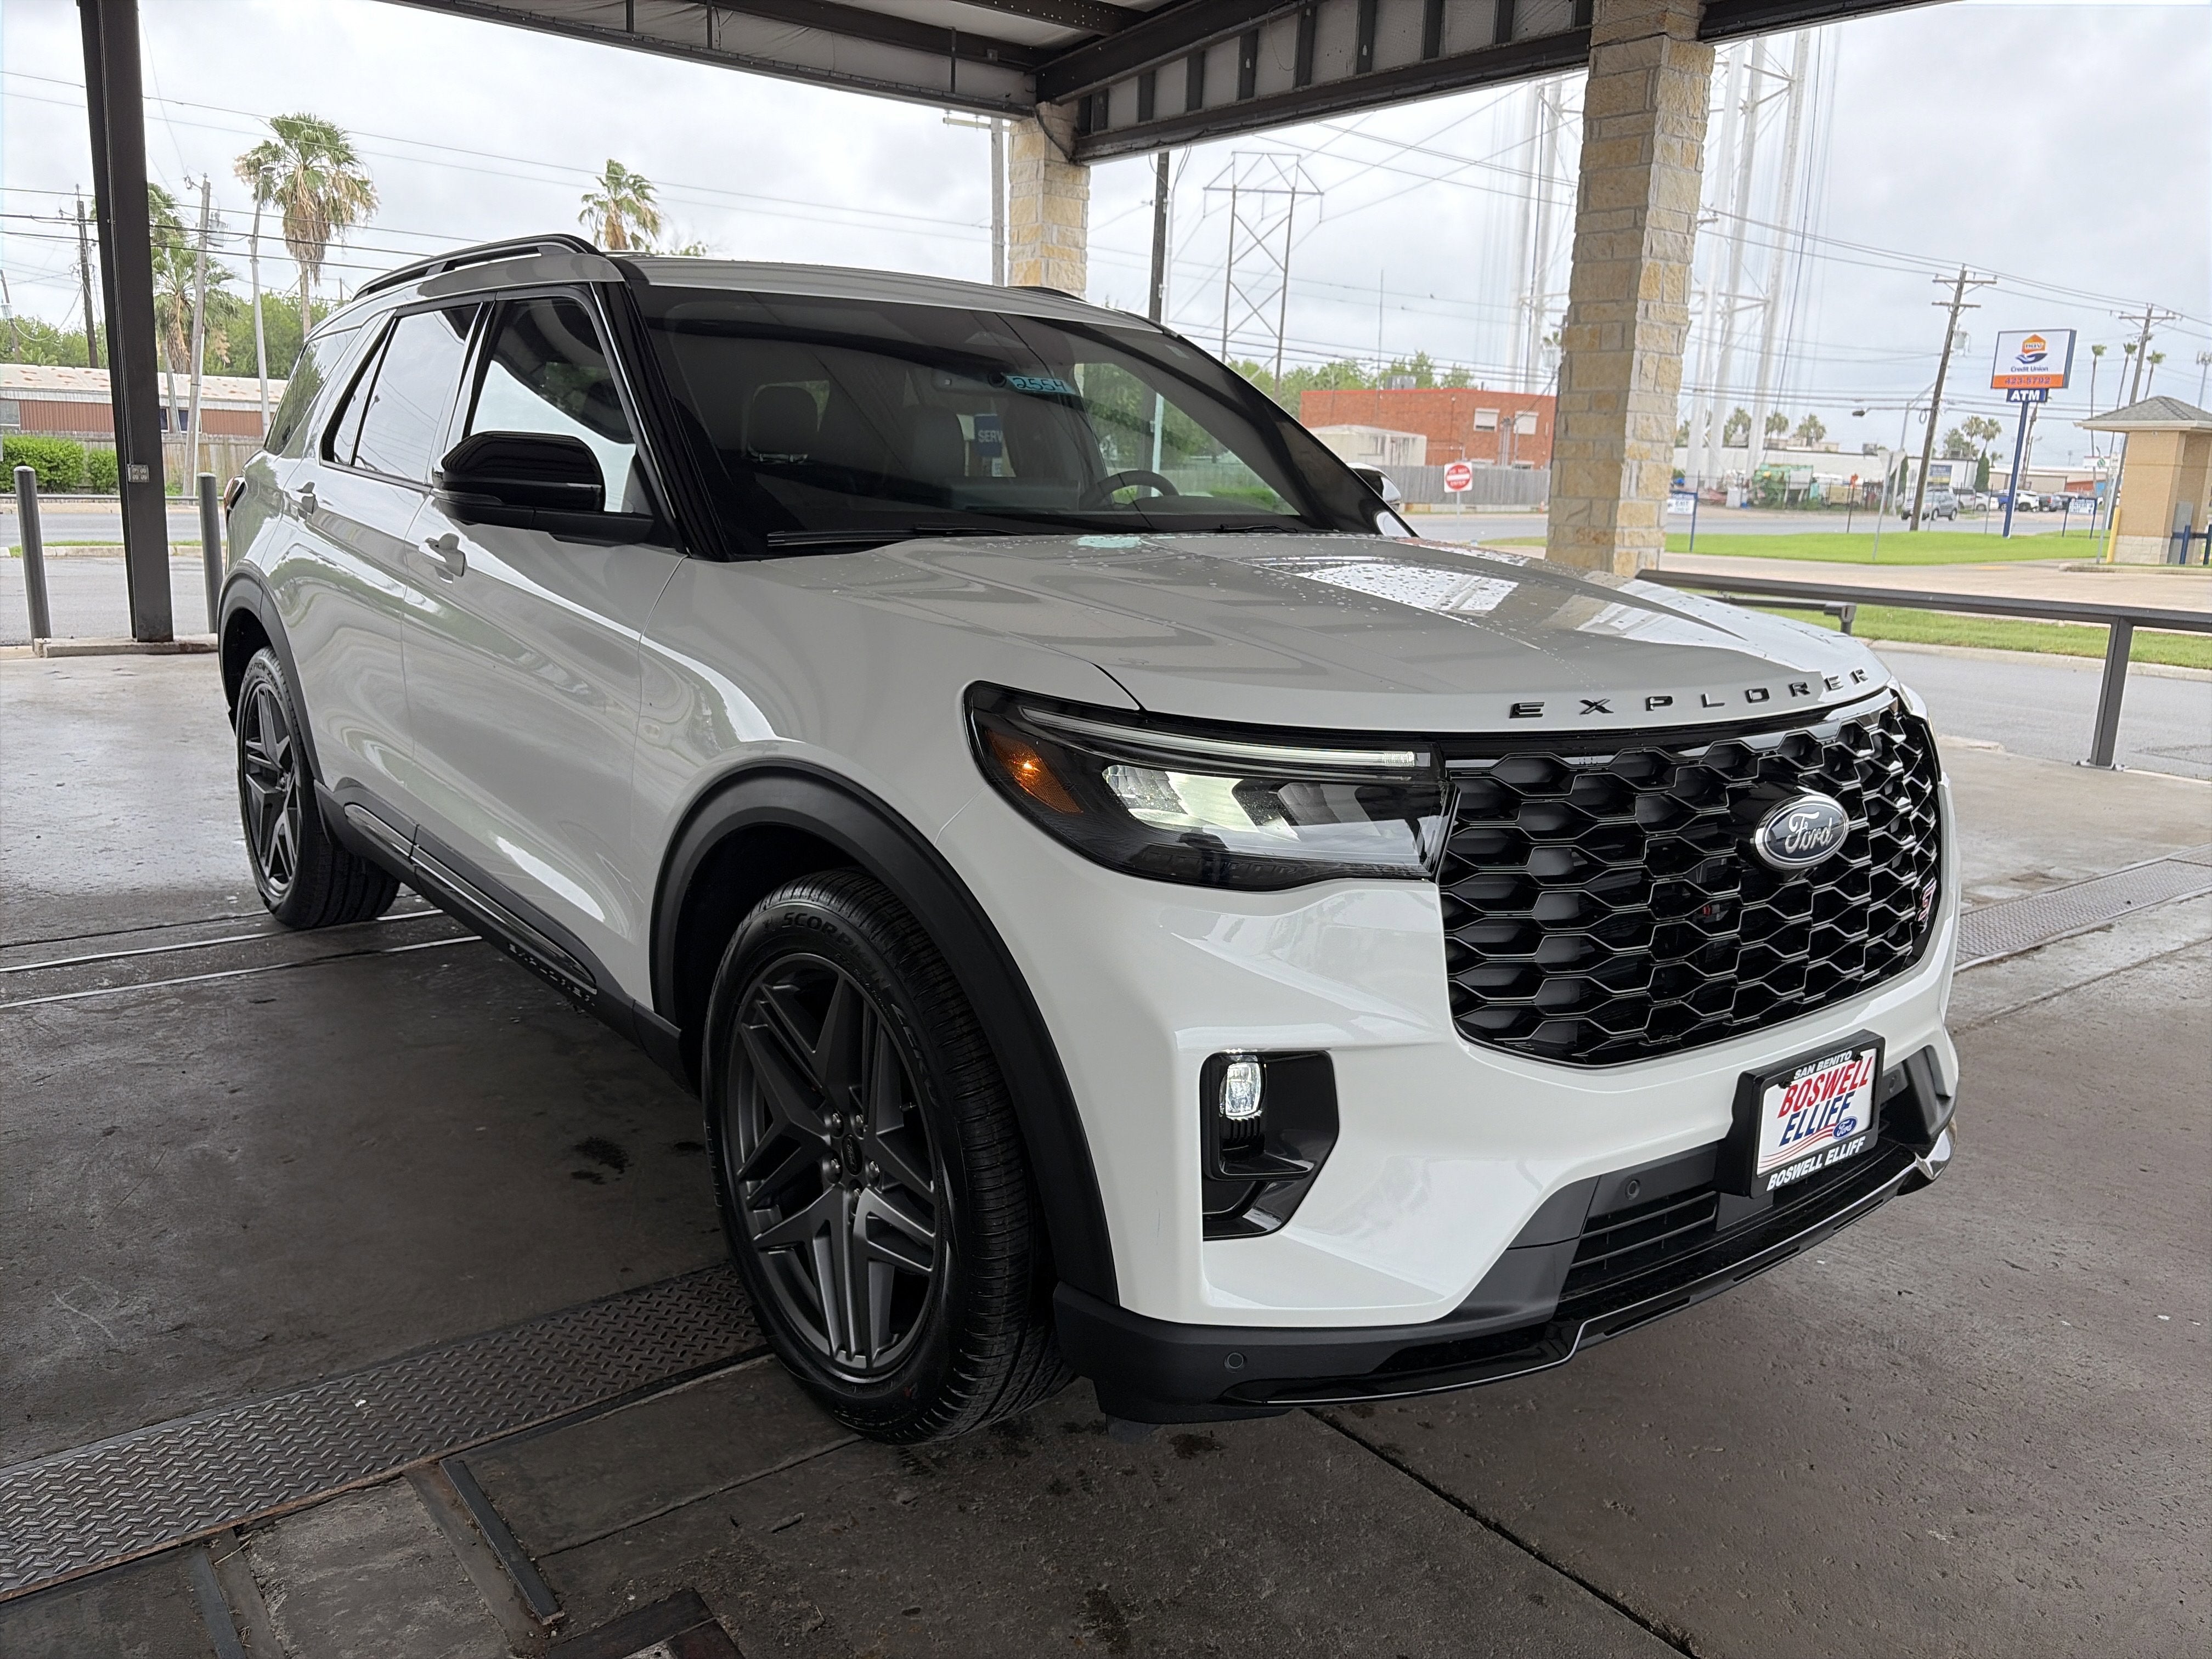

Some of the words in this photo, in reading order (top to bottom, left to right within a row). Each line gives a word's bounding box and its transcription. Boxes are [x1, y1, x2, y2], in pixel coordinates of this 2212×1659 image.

[1012, 377, 1068, 392] 2554
[2010, 390, 2040, 401] ATM
[1509, 668, 1869, 718] EXPLORER
[1785, 811, 1833, 854] Ford
[1793, 1064, 1815, 1080] SAN
[1817, 1050, 1853, 1071] BENITO
[1777, 1056, 1874, 1119] BOSWELL
[1778, 1090, 1857, 1147] ELLIFF
[1837, 1119, 1853, 1137] Ford
[1766, 1153, 1823, 1192] BOSWELL
[1824, 1136, 1866, 1166] ELLIFF
